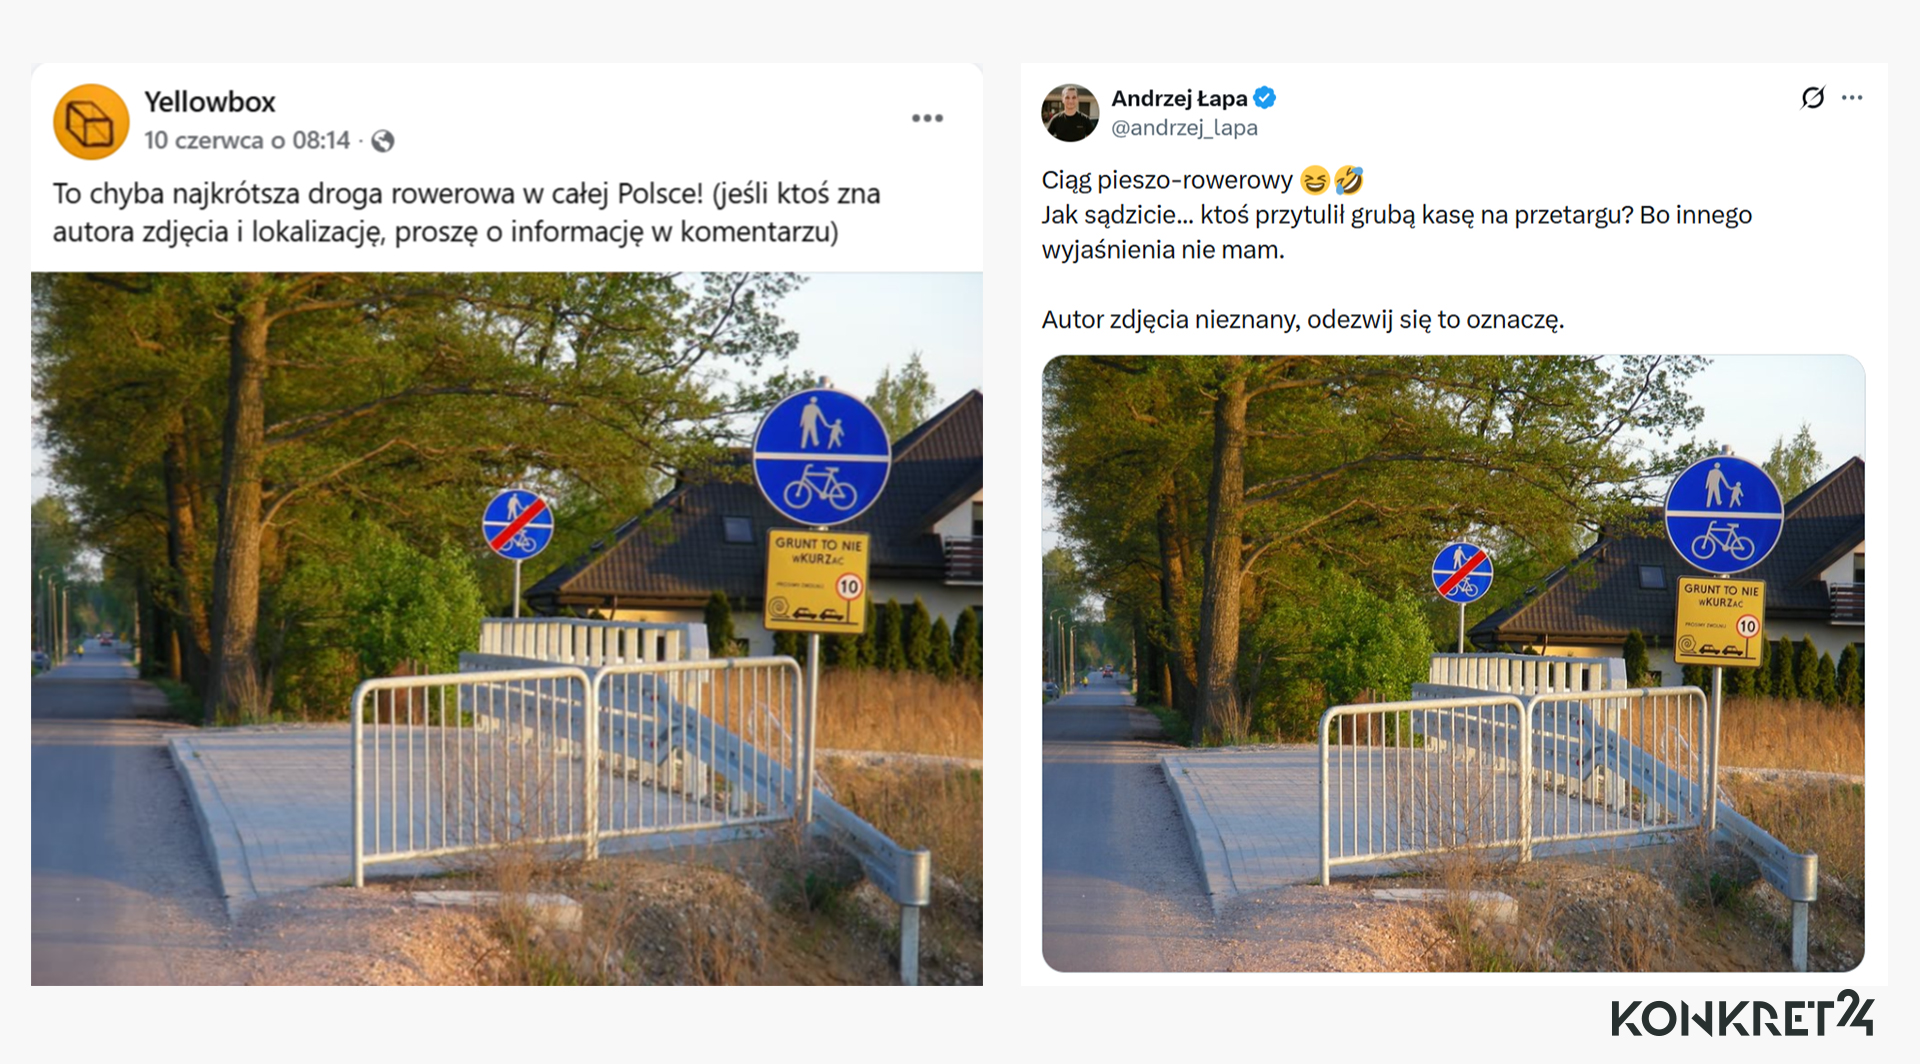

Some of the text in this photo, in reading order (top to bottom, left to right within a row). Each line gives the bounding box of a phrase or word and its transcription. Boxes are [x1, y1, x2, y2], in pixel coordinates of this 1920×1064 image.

[144, 89, 276, 113] Yellowbox
[1111, 88, 1248, 111] Andrzej Łapa
[145, 130, 351, 150] 10 czerwca o 08:14
[1112, 118, 1258, 140] @andrzej_lapa
[1042, 169, 1293, 195] Ciąg pieszo-rowerowy
[52, 180, 880, 210] To chyba najkrótsza droga rowerowa w całej Polsce! (jeśli ktoś zna
[1042, 203, 1752, 229] Jak sądzicie... ktoś przytulił grubą kasę na przetargu? Bo innego
[53, 219, 838, 249] autora zdjęcia i lokalizację, proszę o informację w komentarzu)
[1042, 238, 1284, 264] wyjaśnienia nie mam.
[1042, 308, 1564, 334] Autor zdjęcia nieznany, odezwij się to oznaczę.
[775, 537, 862, 552] GRUNT TO NIE
[841, 580, 858, 594] 10
[1684, 583, 1759, 597] GRUNT TO NIE
[1741, 620, 1756, 633] 10
